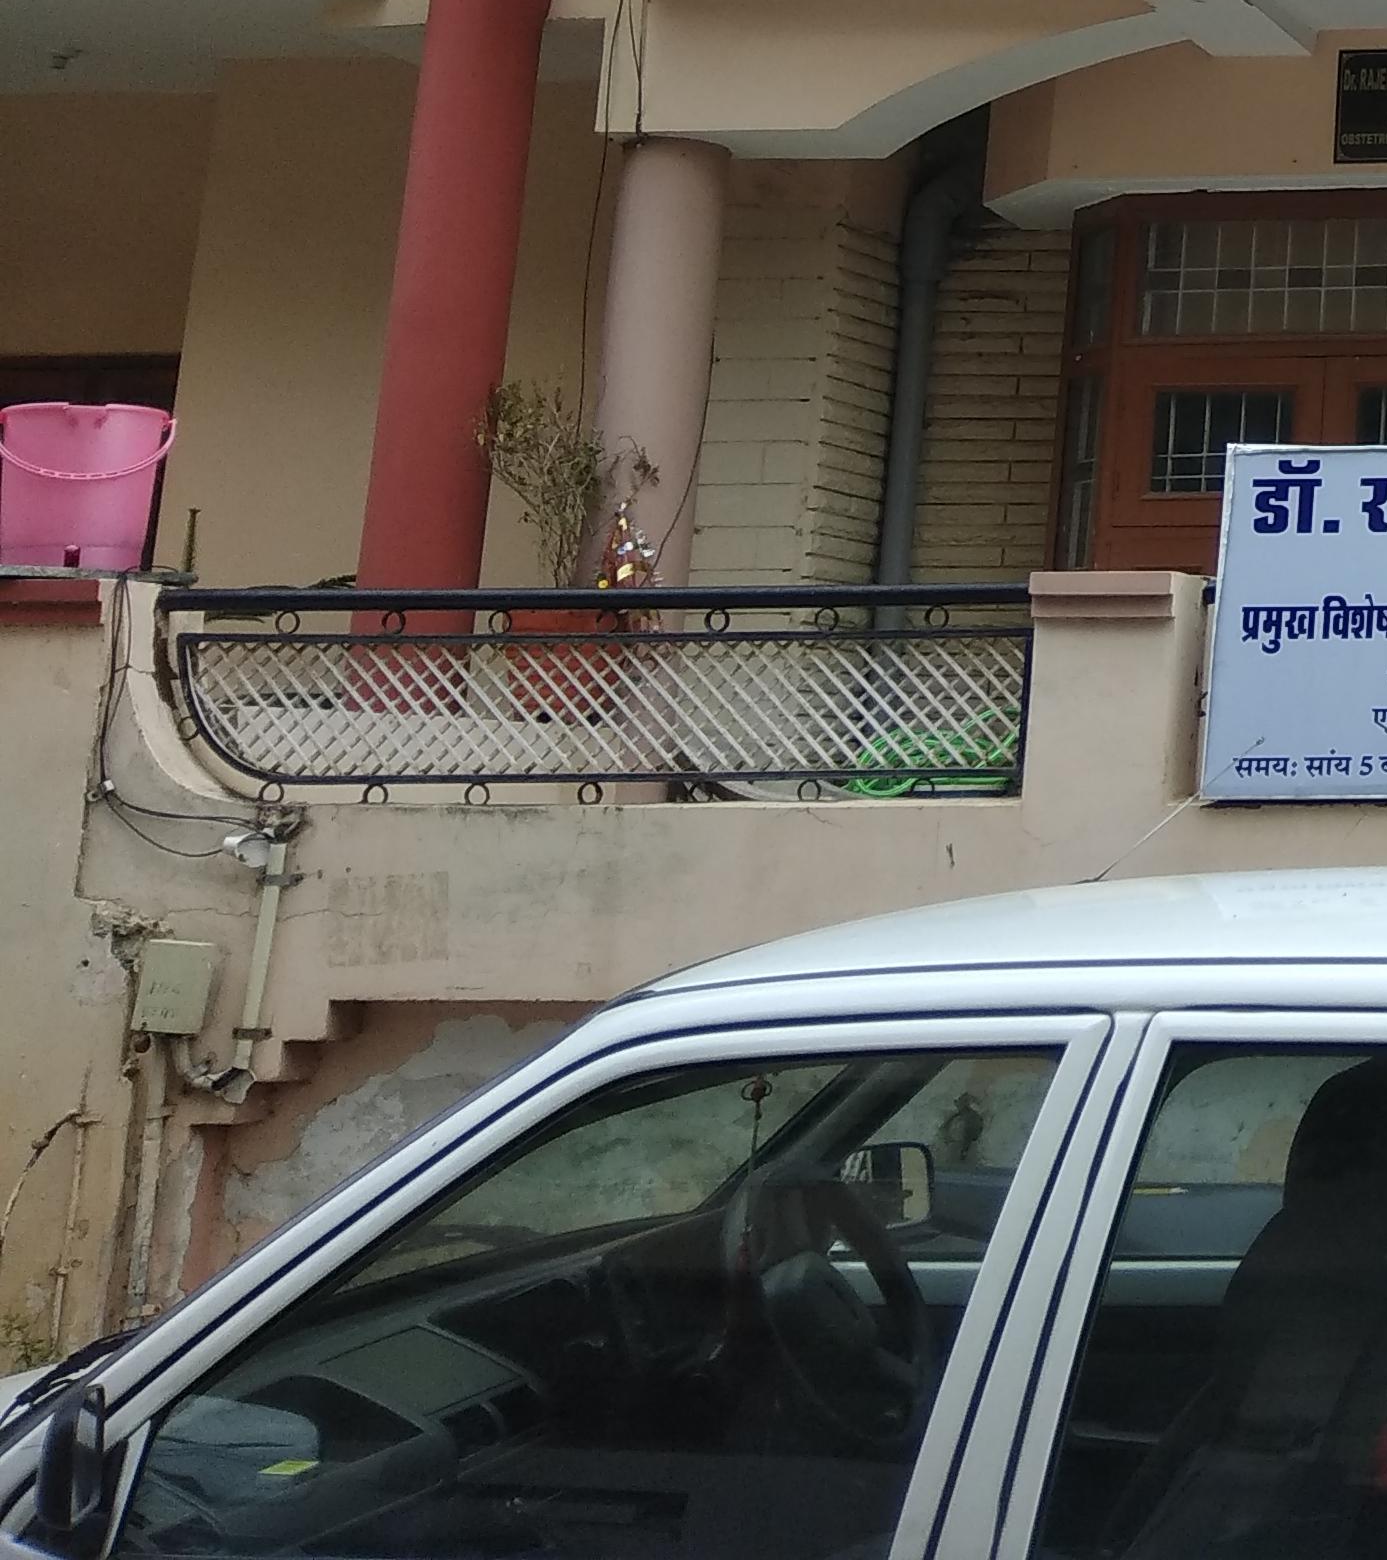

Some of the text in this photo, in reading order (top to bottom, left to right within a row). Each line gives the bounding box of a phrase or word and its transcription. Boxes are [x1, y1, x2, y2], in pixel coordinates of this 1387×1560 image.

[1252, 459, 1339, 533] डॉ.
[1241, 605, 1318, 654] प्रमुख
[1303, 748, 1351, 777] सांय
[1358, 755, 1373, 776] 5
